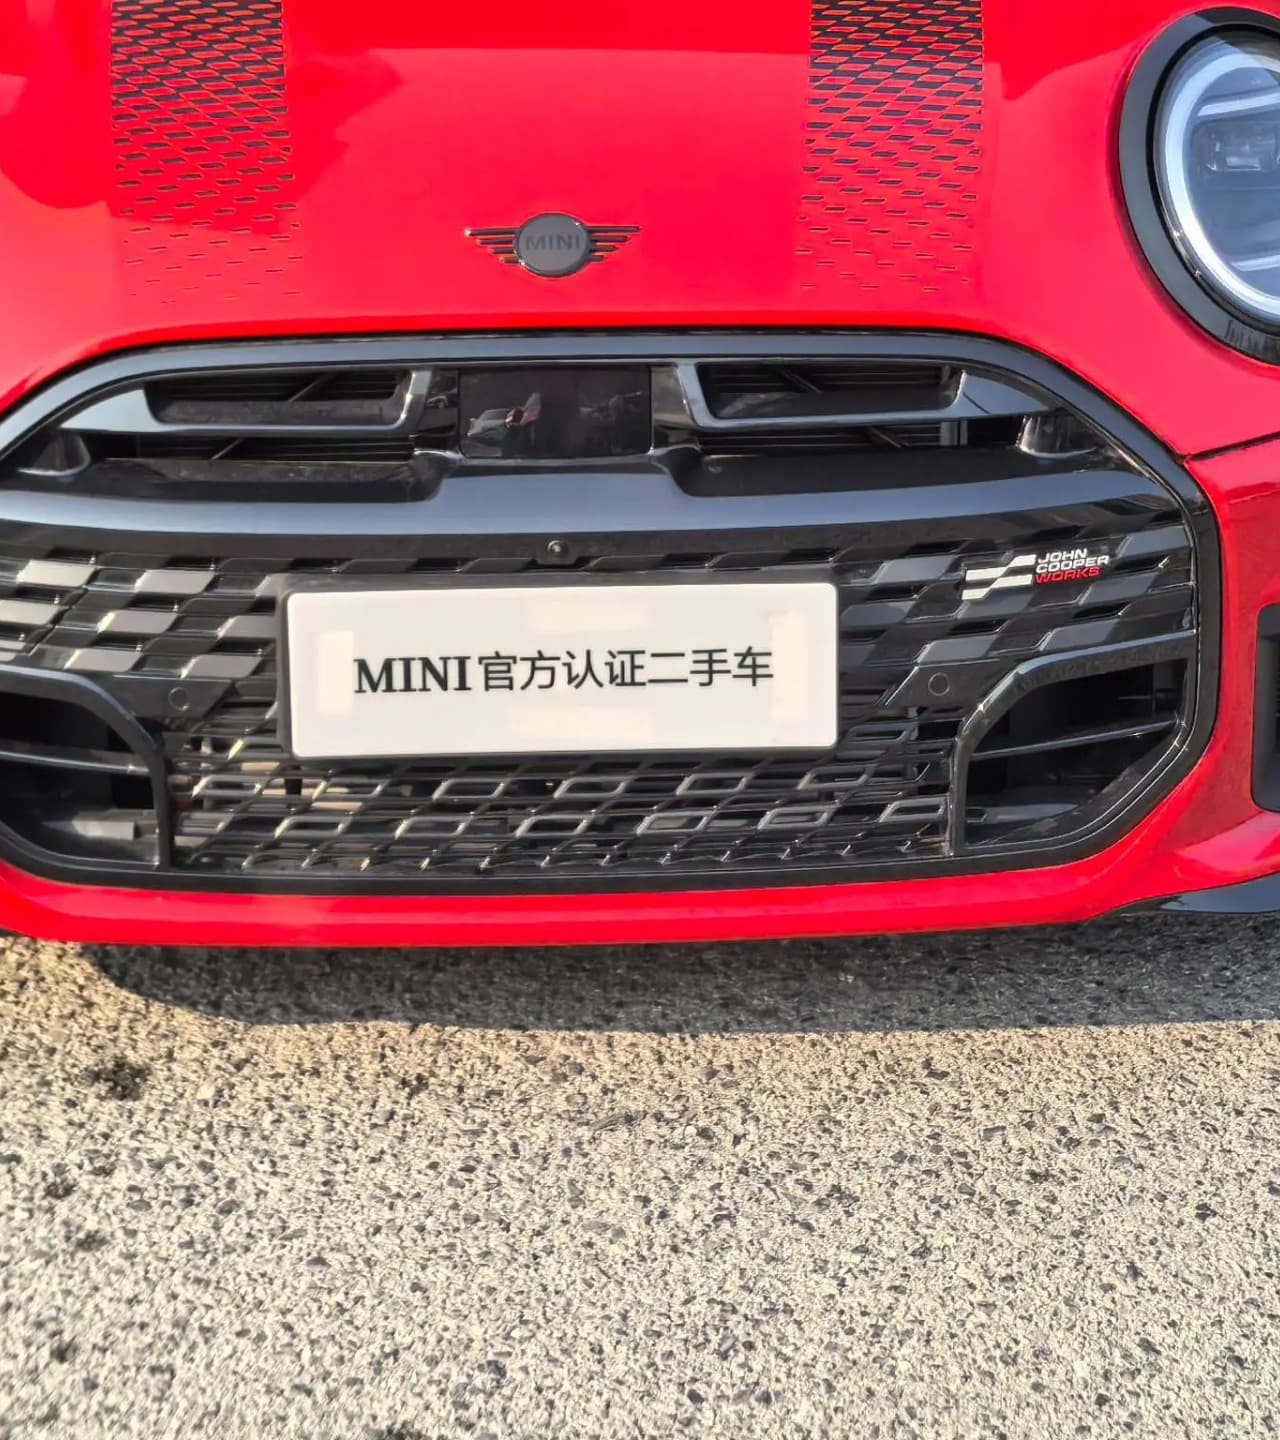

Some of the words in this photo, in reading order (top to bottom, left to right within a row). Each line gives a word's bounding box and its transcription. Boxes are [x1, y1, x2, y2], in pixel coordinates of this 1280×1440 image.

[525, 233, 581, 251] MINI
[1035, 555, 1110, 574] COOPER
[1037, 548, 1088, 564] JOHN
[1035, 566, 1102, 584] WORKS
[478, 646, 775, 693] 官方认证二手车
